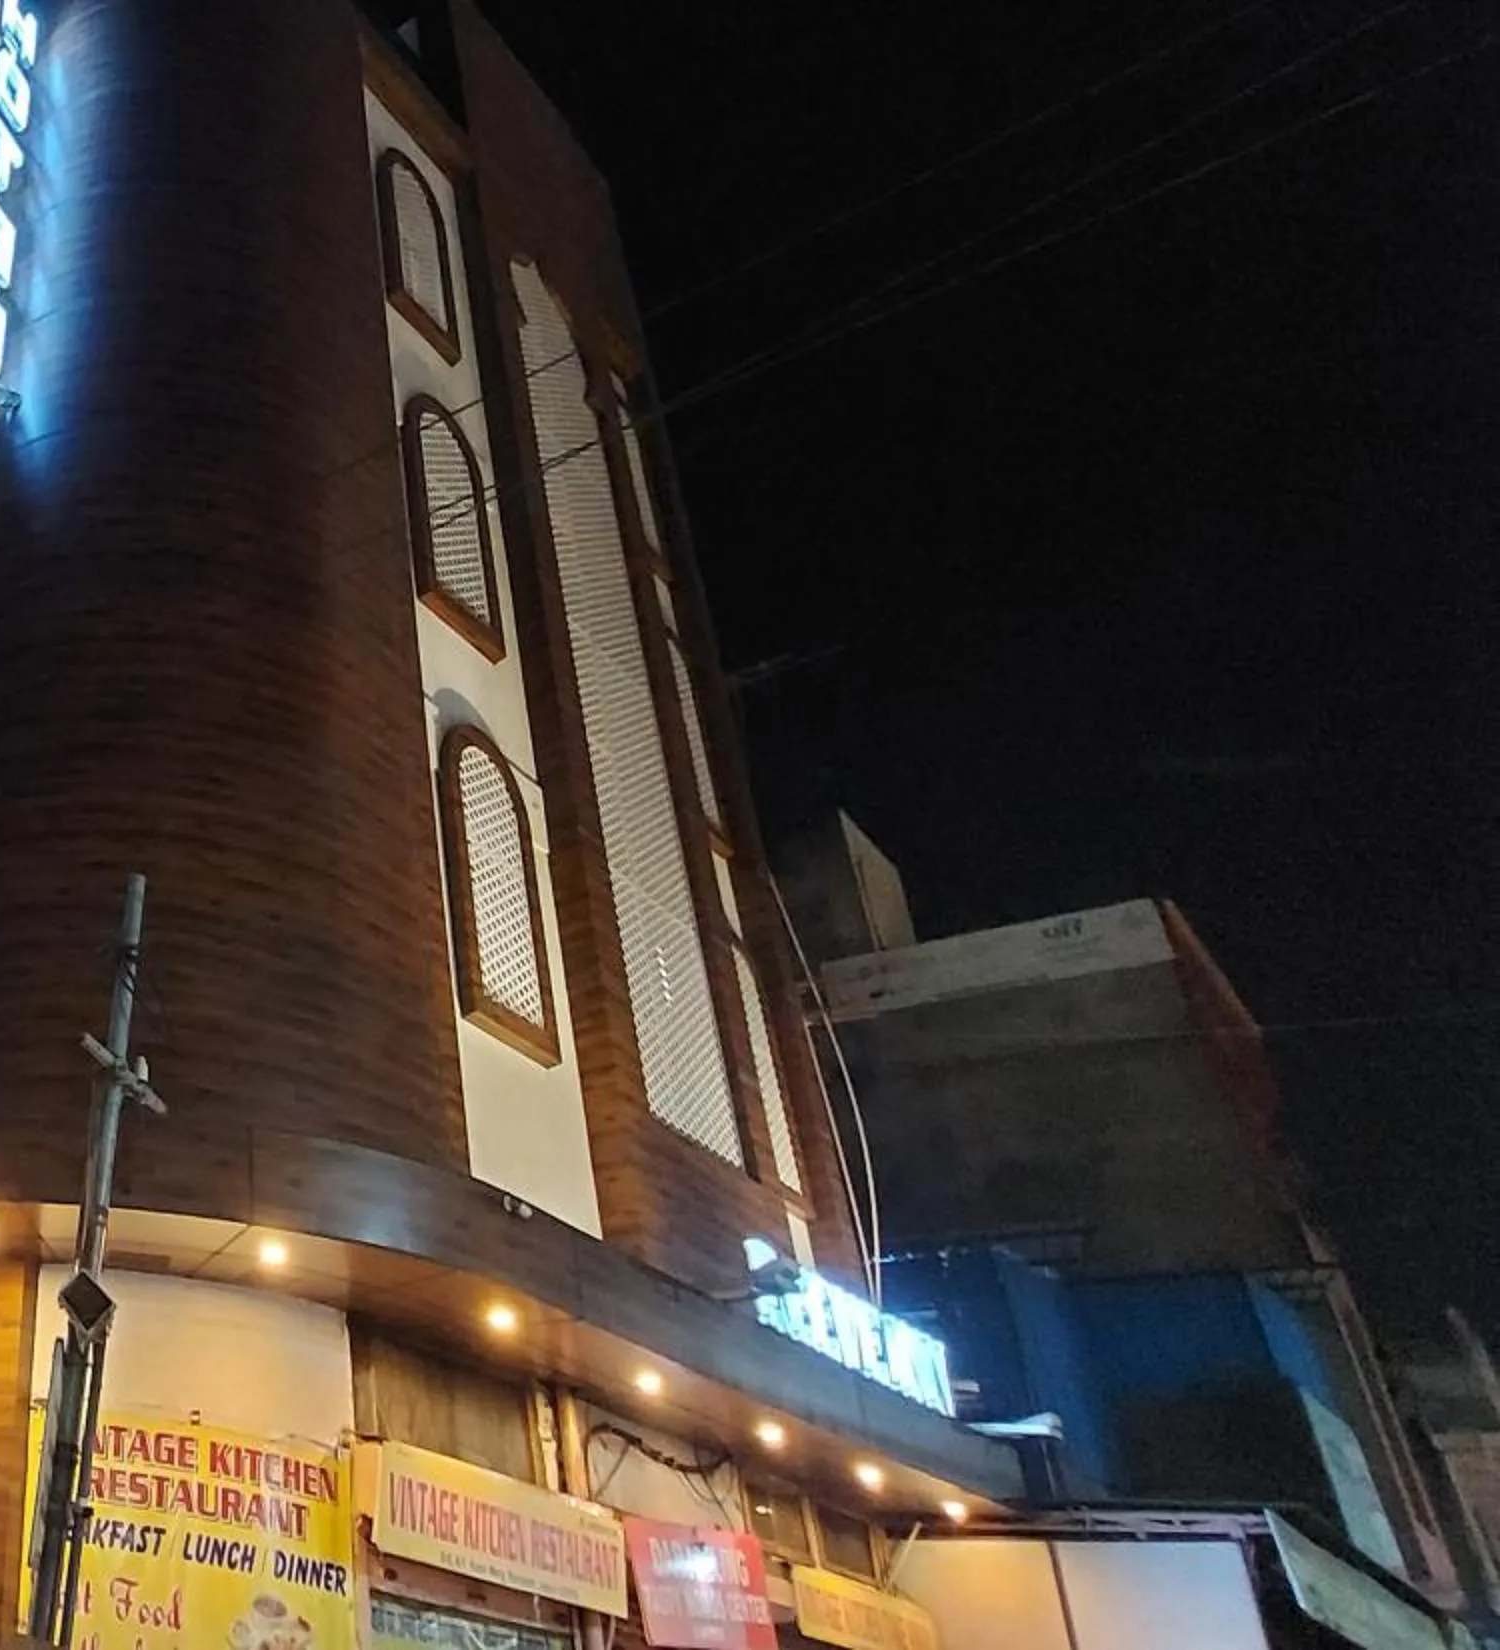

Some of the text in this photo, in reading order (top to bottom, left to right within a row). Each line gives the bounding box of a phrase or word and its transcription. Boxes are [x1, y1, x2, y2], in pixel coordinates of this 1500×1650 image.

[92, 1424, 339, 1502] TAGE KITCHEN
[92, 1466, 308, 1537] RESTAURANT
[83, 1517, 347, 1597] KFAST LUNCH DINNER
[389, 1471, 459, 1544] VINTAGE
[463, 1495, 527, 1564] KITCHEN
[531, 1518, 619, 1591] RESTAURANT
[110, 1577, 183, 1629] Food
